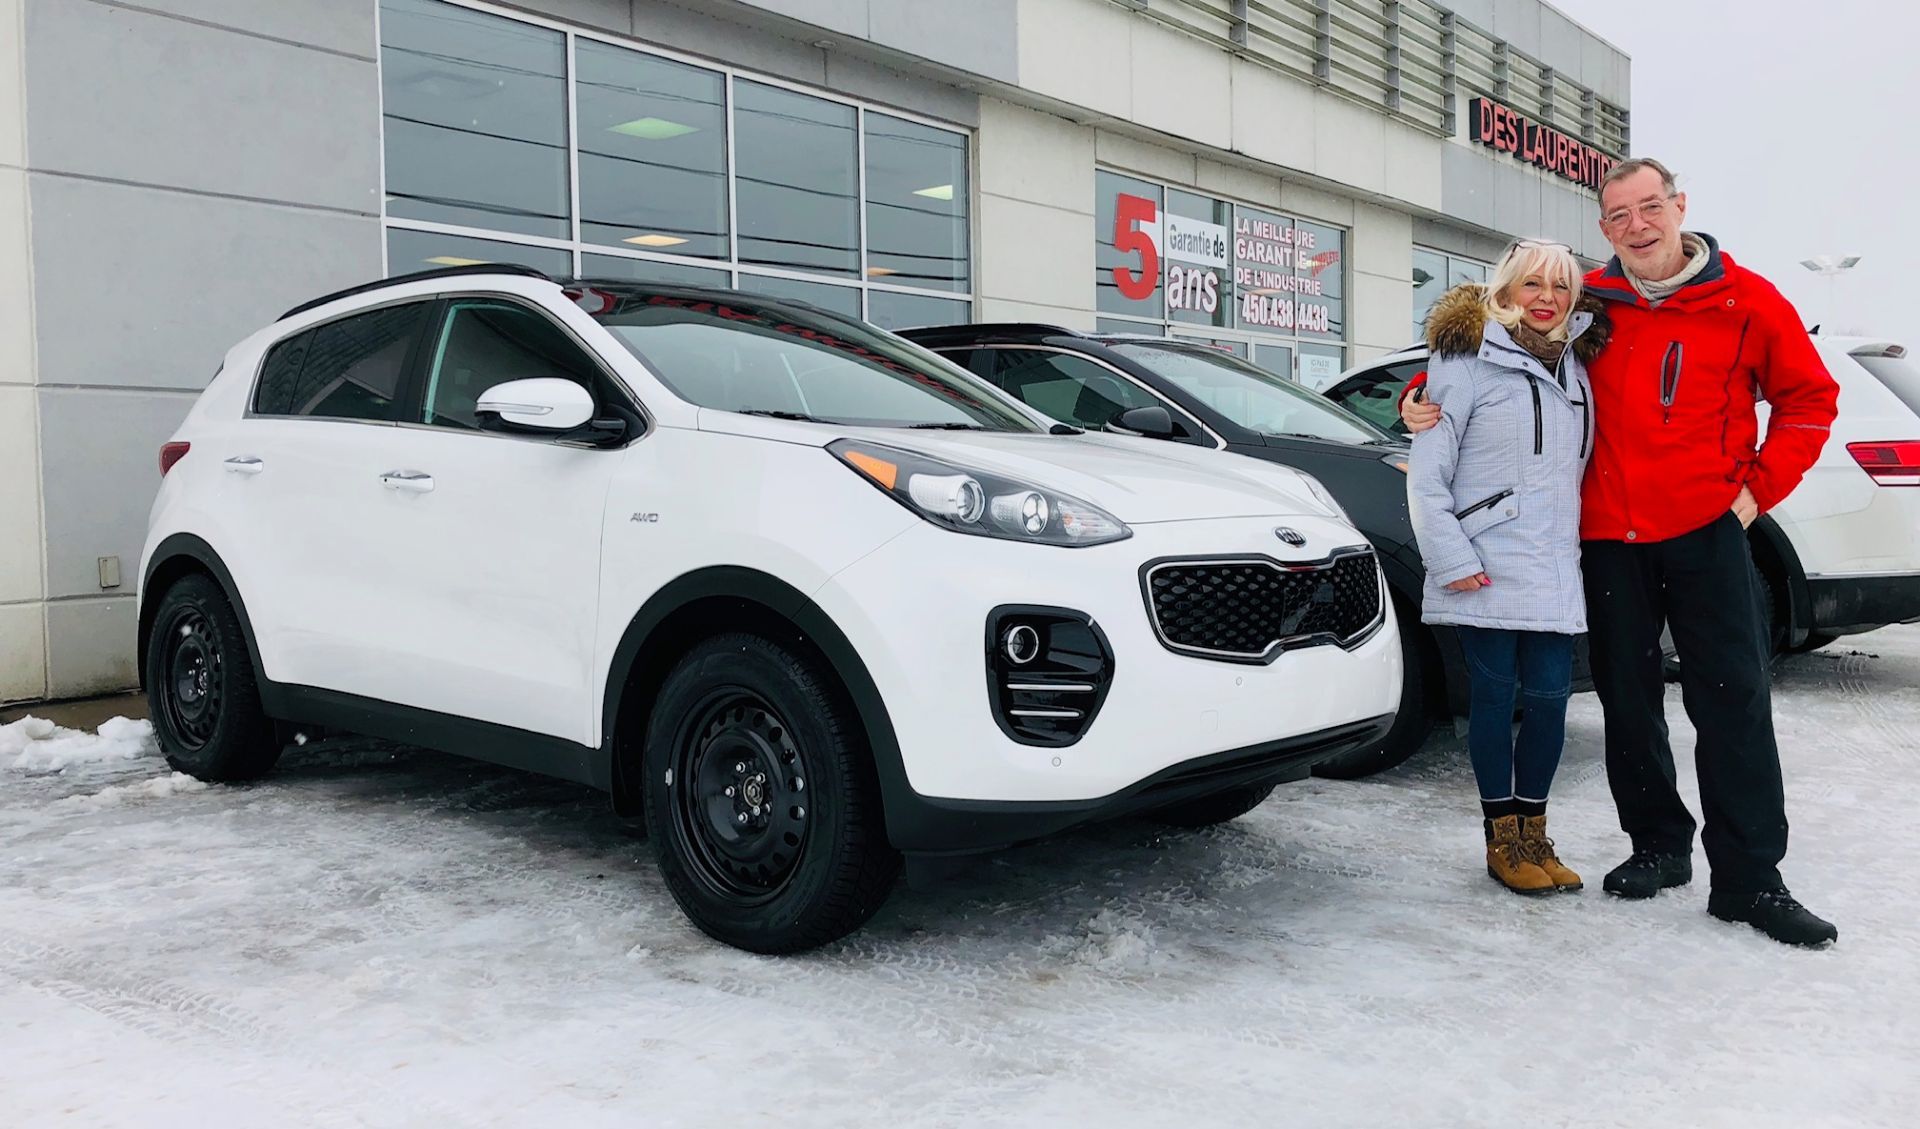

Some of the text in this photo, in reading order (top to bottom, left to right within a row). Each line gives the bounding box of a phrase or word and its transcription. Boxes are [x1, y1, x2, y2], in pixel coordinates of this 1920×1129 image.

[1480, 97, 1620, 189] DES LAURENTID
[1112, 192, 1159, 301] 5
[1169, 223, 1225, 260] Garantie de
[1236, 216, 1315, 249] LA MEILLEURE
[1236, 238, 1308, 271] GARANTIE
[1168, 265, 1218, 313] ans
[1236, 267, 1321, 297] DE L'INDUSTRIE
[629, 512, 659, 523] AWD
